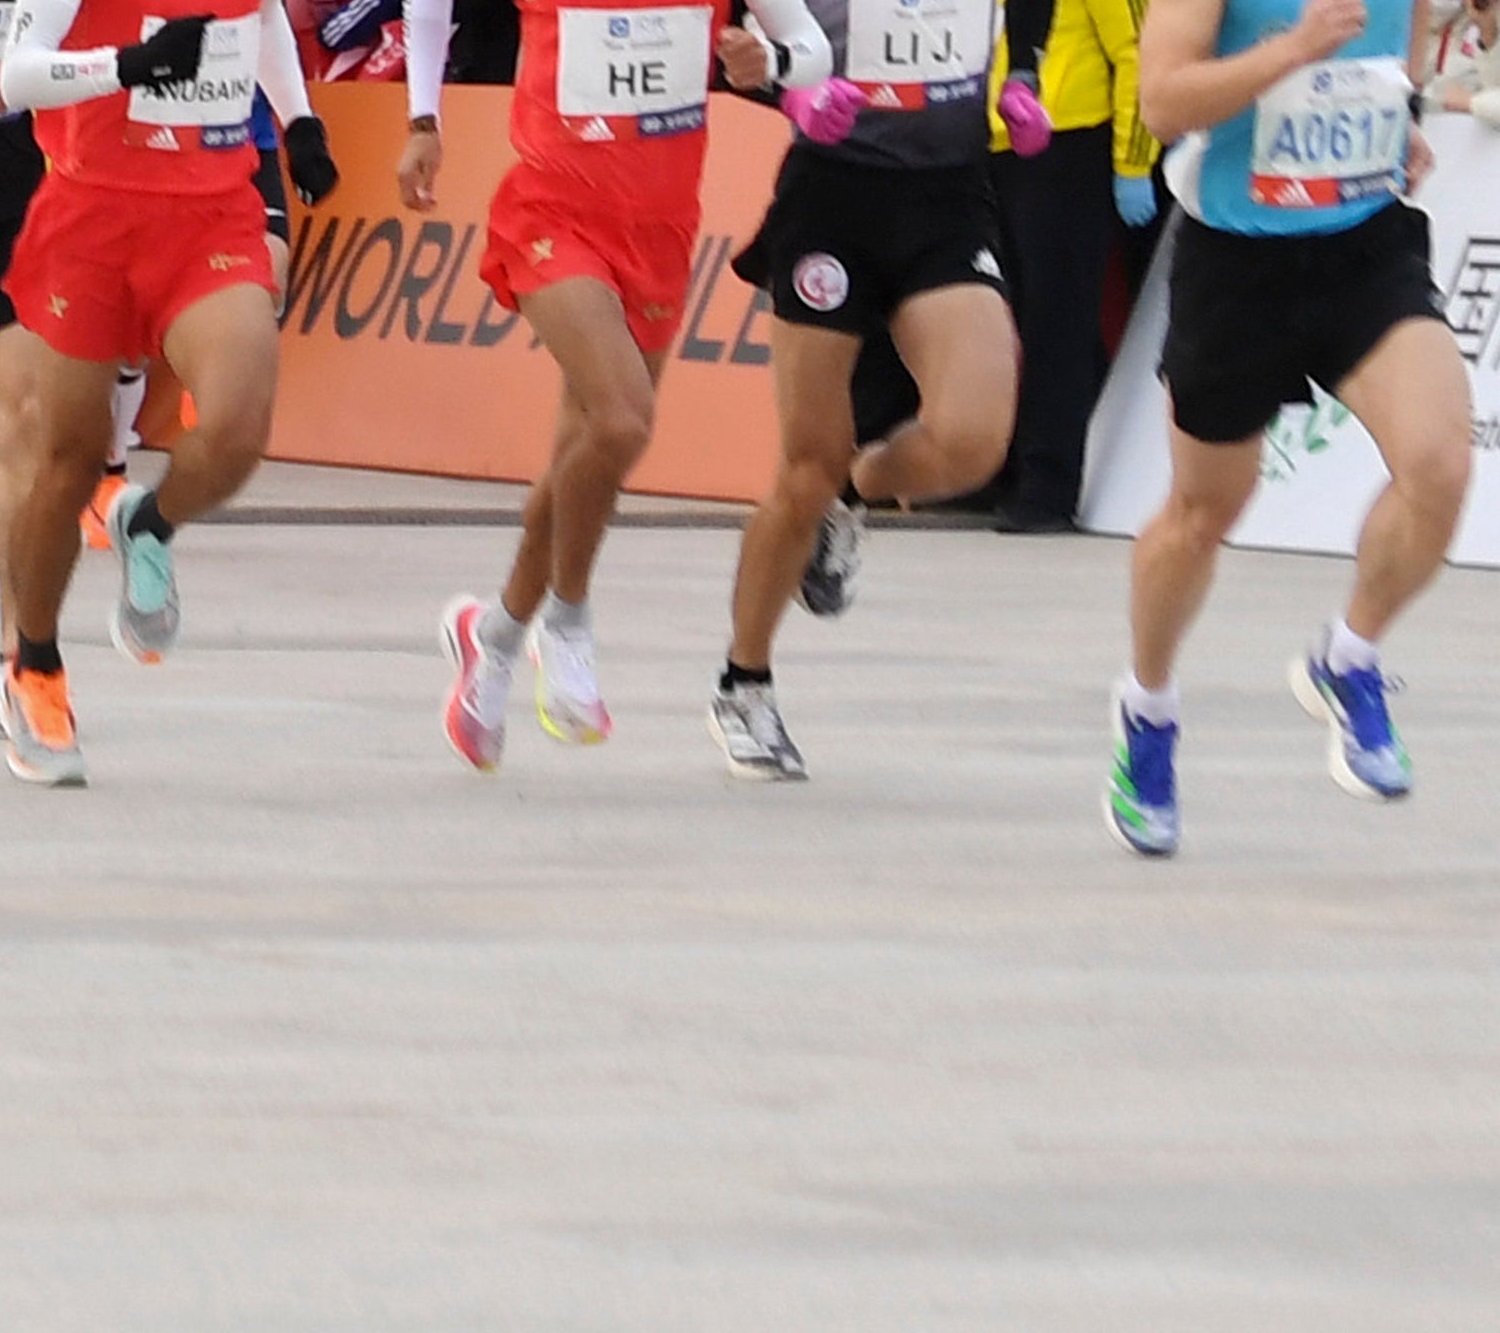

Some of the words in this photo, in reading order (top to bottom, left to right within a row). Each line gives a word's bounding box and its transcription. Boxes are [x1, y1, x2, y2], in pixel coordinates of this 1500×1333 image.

[885, 31, 919, 65] LI
[608, 62, 666, 96] HE
[1269, 109, 1397, 162] A0617
